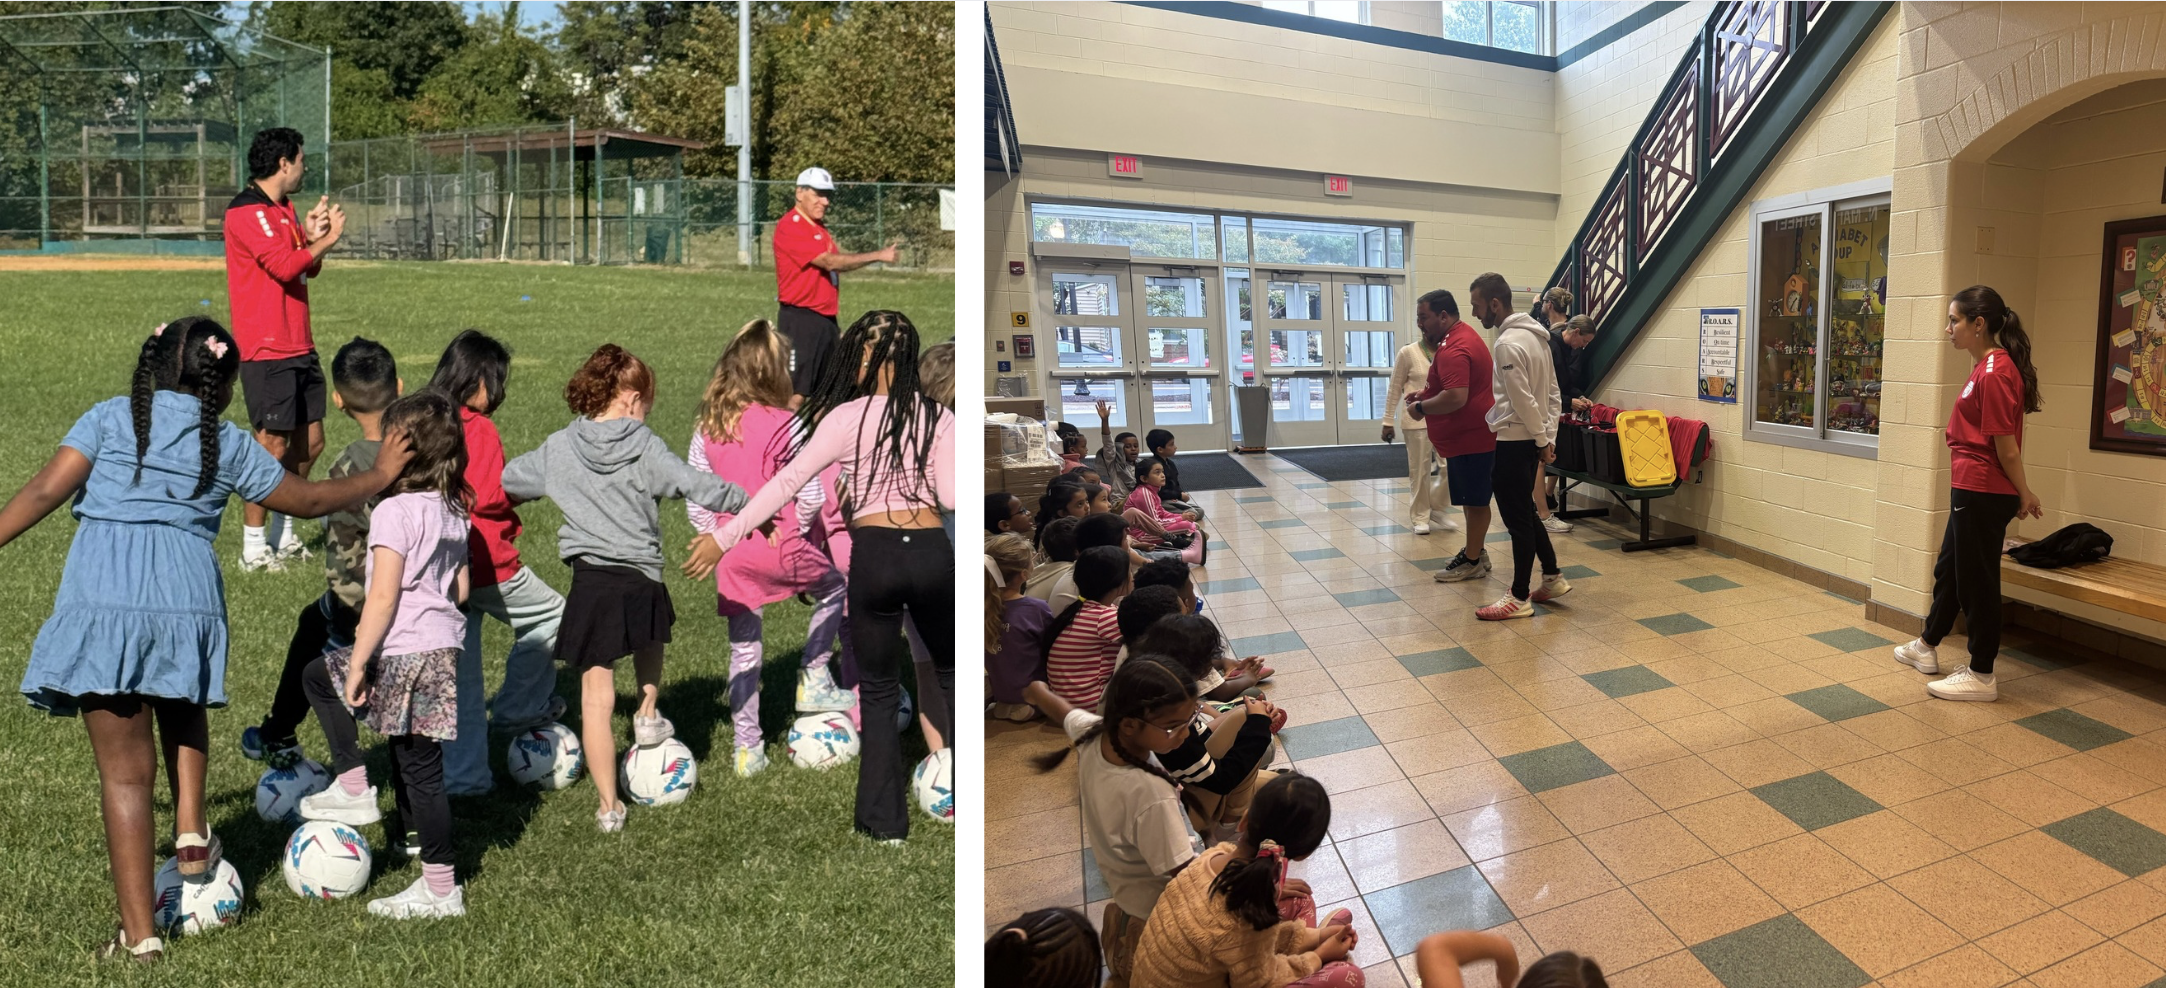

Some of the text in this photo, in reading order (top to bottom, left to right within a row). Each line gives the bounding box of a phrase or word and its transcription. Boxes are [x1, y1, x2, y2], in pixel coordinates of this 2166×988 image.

[1115, 155, 1137, 173] EXIT
[1330, 176, 1348, 192] EXIT
[1016, 314, 1026, 325] 9
